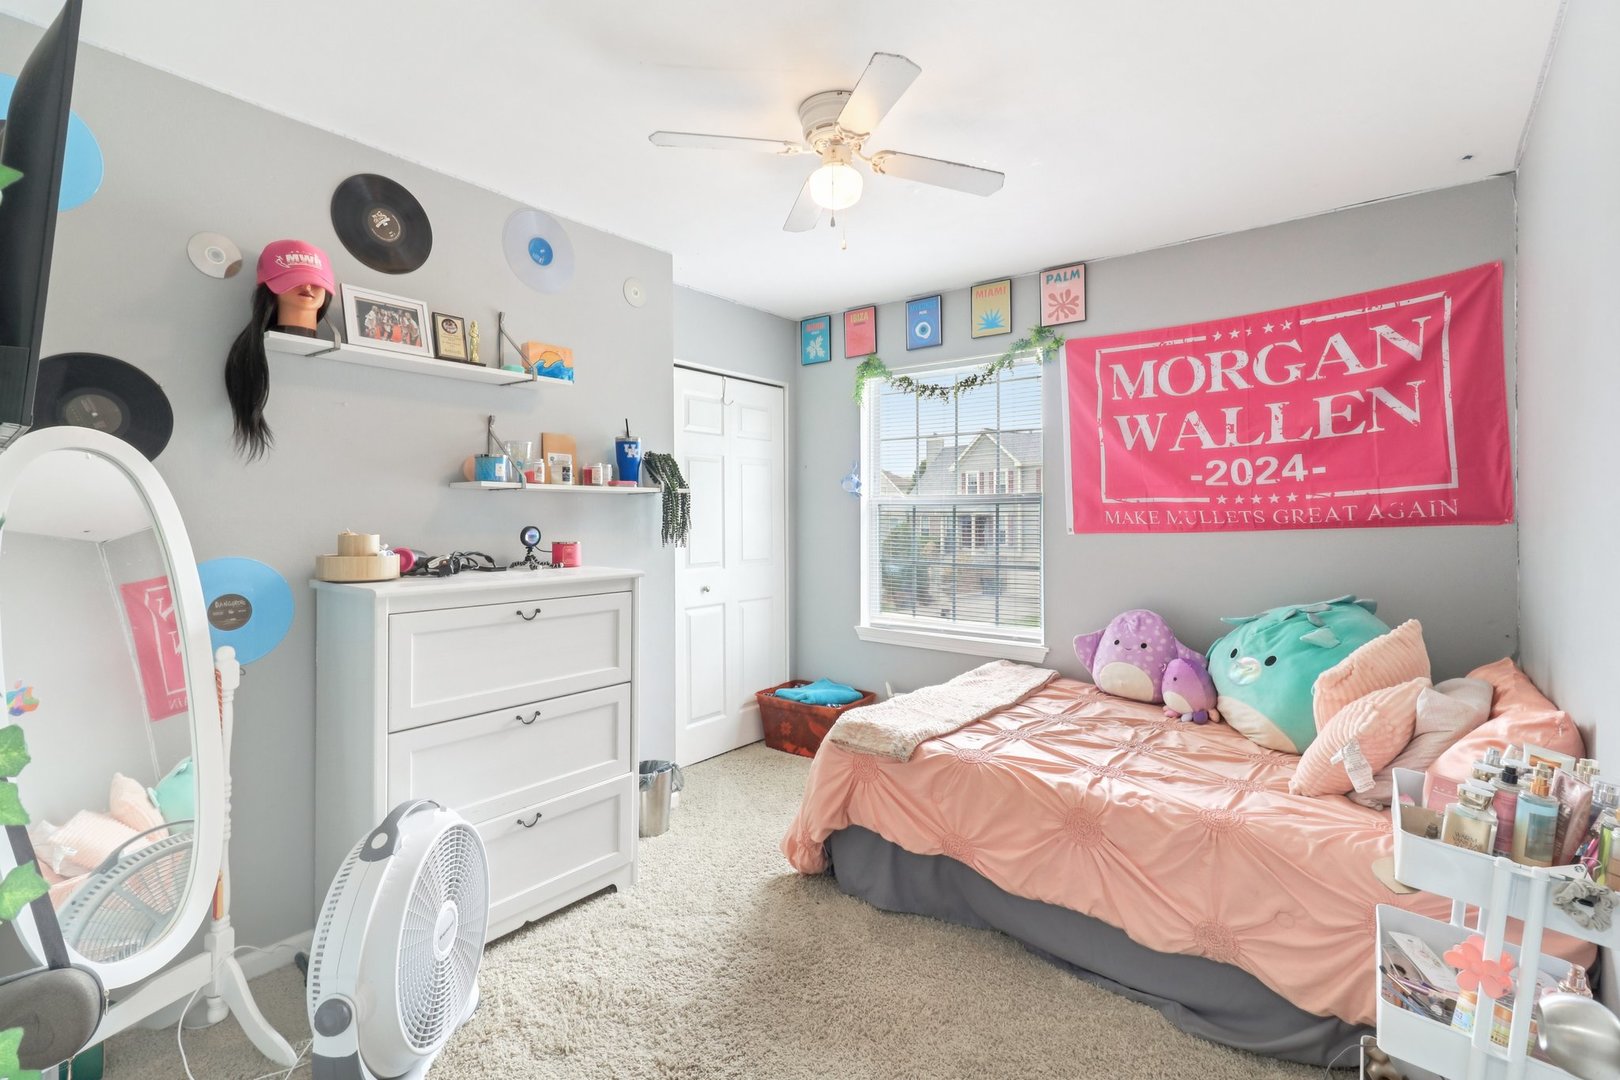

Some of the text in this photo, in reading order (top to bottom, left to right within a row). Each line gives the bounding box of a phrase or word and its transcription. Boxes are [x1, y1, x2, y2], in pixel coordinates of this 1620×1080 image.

[1046, 269, 1080, 285] PALM
[975, 286, 1006, 299] MIAMI
[1109, 316, 1431, 400] MORGAN
[1113, 380, 1426, 452] WALLEN
[1191, 454, 1326, 486] -2024-
[1105, 499, 1459, 525] MAKE MULLETS GREAT AGAIN
